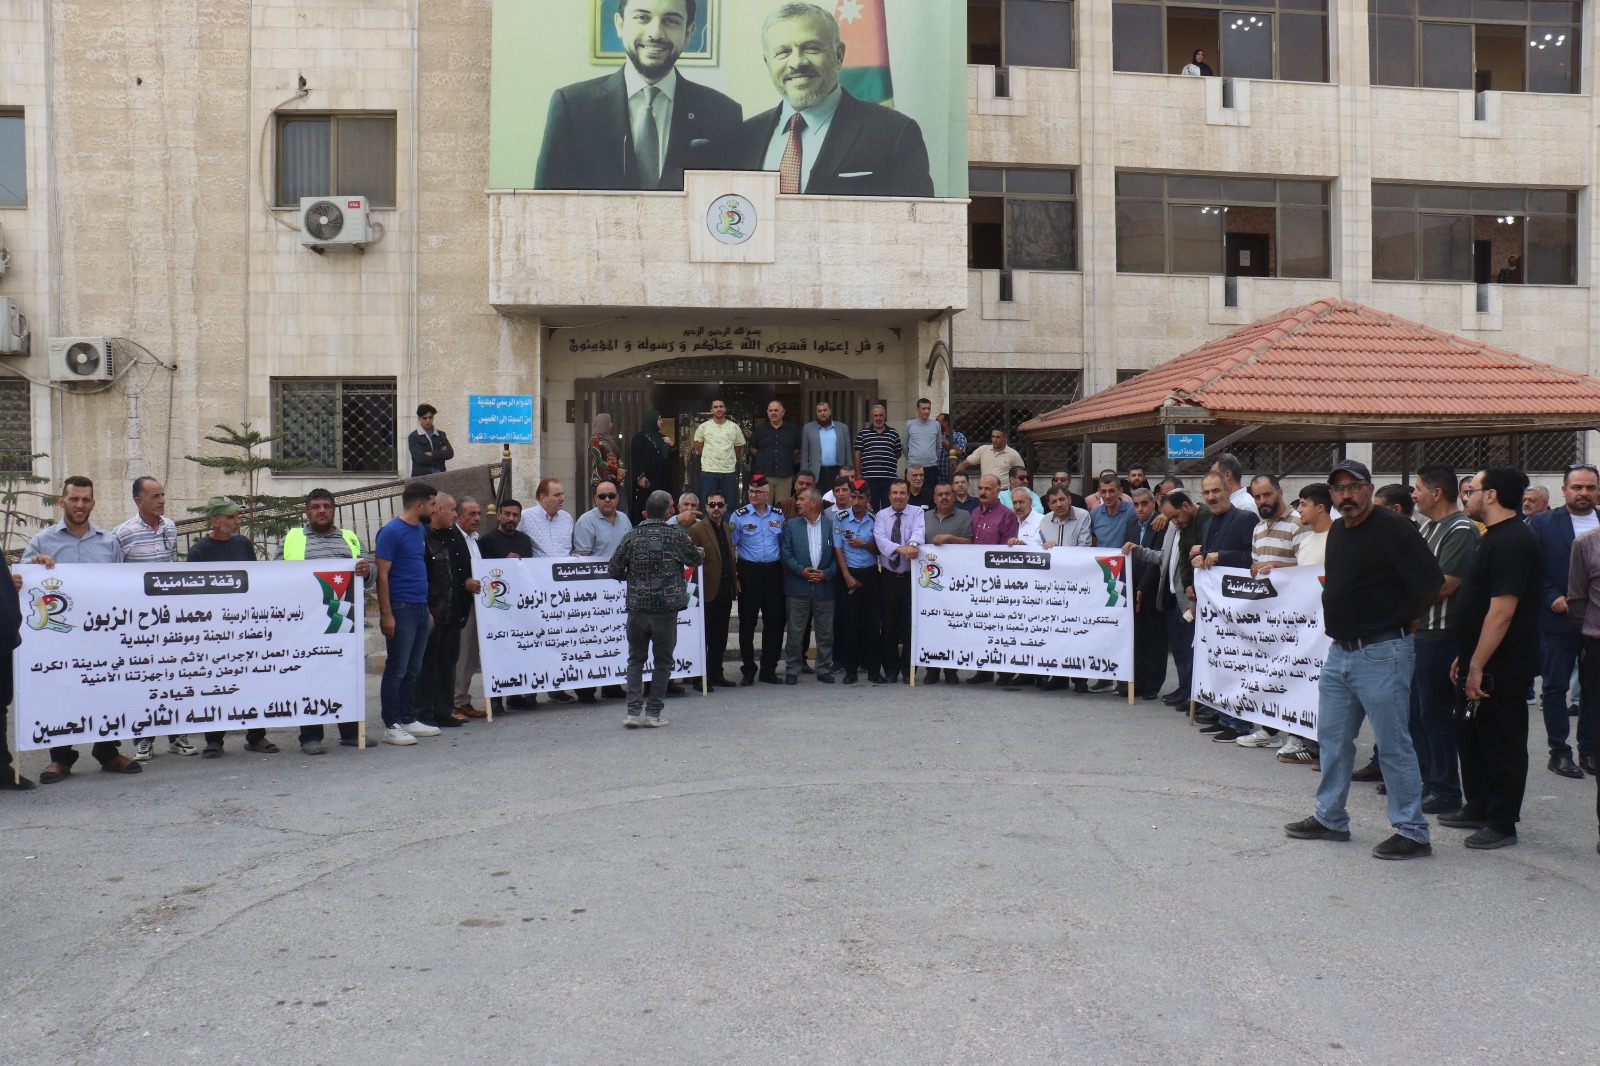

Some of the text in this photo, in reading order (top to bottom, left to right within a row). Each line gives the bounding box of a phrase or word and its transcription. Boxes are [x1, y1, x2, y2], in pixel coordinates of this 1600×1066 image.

[683, 326, 761, 337] بسم الله الرحمن الرحيم
[508, 415, 524, 424] السبت
[989, 553, 1046, 567] وقفة تضامنية
[556, 565, 608, 578] قفة تضامنية
[152, 574, 241, 591] وقفة تضامنية
[948, 574, 1091, 594] رئيس لجنة بلدية الرصيفة محمد فلاح الزبون
[517, 589, 547, 609] الزبون
[550, 588, 571, 607] فلاح
[573, 590, 598, 602] محمد
[970, 593, 1069, 608] وأعضاء اللجنة وموظفو البلدية
[83, 604, 304, 632] رئيس لجنة بلدية الرصيفة محمد فلاح الزبون
[541, 610, 566, 621] البلدية
[567, 608, 591, 619] وموظفو
[592, 606, 614, 617] اللجنة
[920, 608, 941, 617] الكرك
[942, 608, 964, 618] مدينة
[964, 610, 973, 620] في
[1236, 612, 1261, 624] محمد
[947, 619, 972, 629] الأمنية
[973, 621, 1004, 631] وأجهزتنا
[1006, 622, 1029, 633] وشعبنا
[1082, 616, 1119, 626] يستنكرون
[486, 630, 509, 640] الكرك
[510, 629, 534, 638] مدينة
[535, 628, 545, 638] في
[1030, 624, 1052, 633] الوطن
[120, 626, 273, 648] وأعضاء اللجنة وموظفو البلدية
[603, 635, 626, 644] الوطن
[987, 636, 1047, 647] خلف قيادة
[212, 650, 258, 664] الإجرامي
[261, 649, 289, 660] العمل
[292, 645, 343, 659] يستنكرون
[561, 649, 621, 662] خلف قيادة
[71, 658, 107, 671] مدينة
[111, 656, 125, 671] في
[129, 654, 154, 666] أهلنا
[157, 654, 177, 664] ضد
[919, 647, 1119, 676] جلالة الملك عبد الله الثاني ابن الحسين
[30, 660, 68, 674] الكرك
[587, 665, 611, 679] الله
[81, 663, 302, 686] حمى الله الوطن وشعبنا وأجهزتنا الأمنية
[531, 671, 549, 689] ابن
[552, 664, 584, 689] الثاني
[491, 672, 527, 693] الحسين
[1240, 678, 1287, 694] خلف قيادة
[149, 683, 240, 701] خلف قيادة
[32, 696, 343, 744] جلالة الملك عبد الله الثاني ابن الحسين
[1281, 706, 1297, 728] عبد
